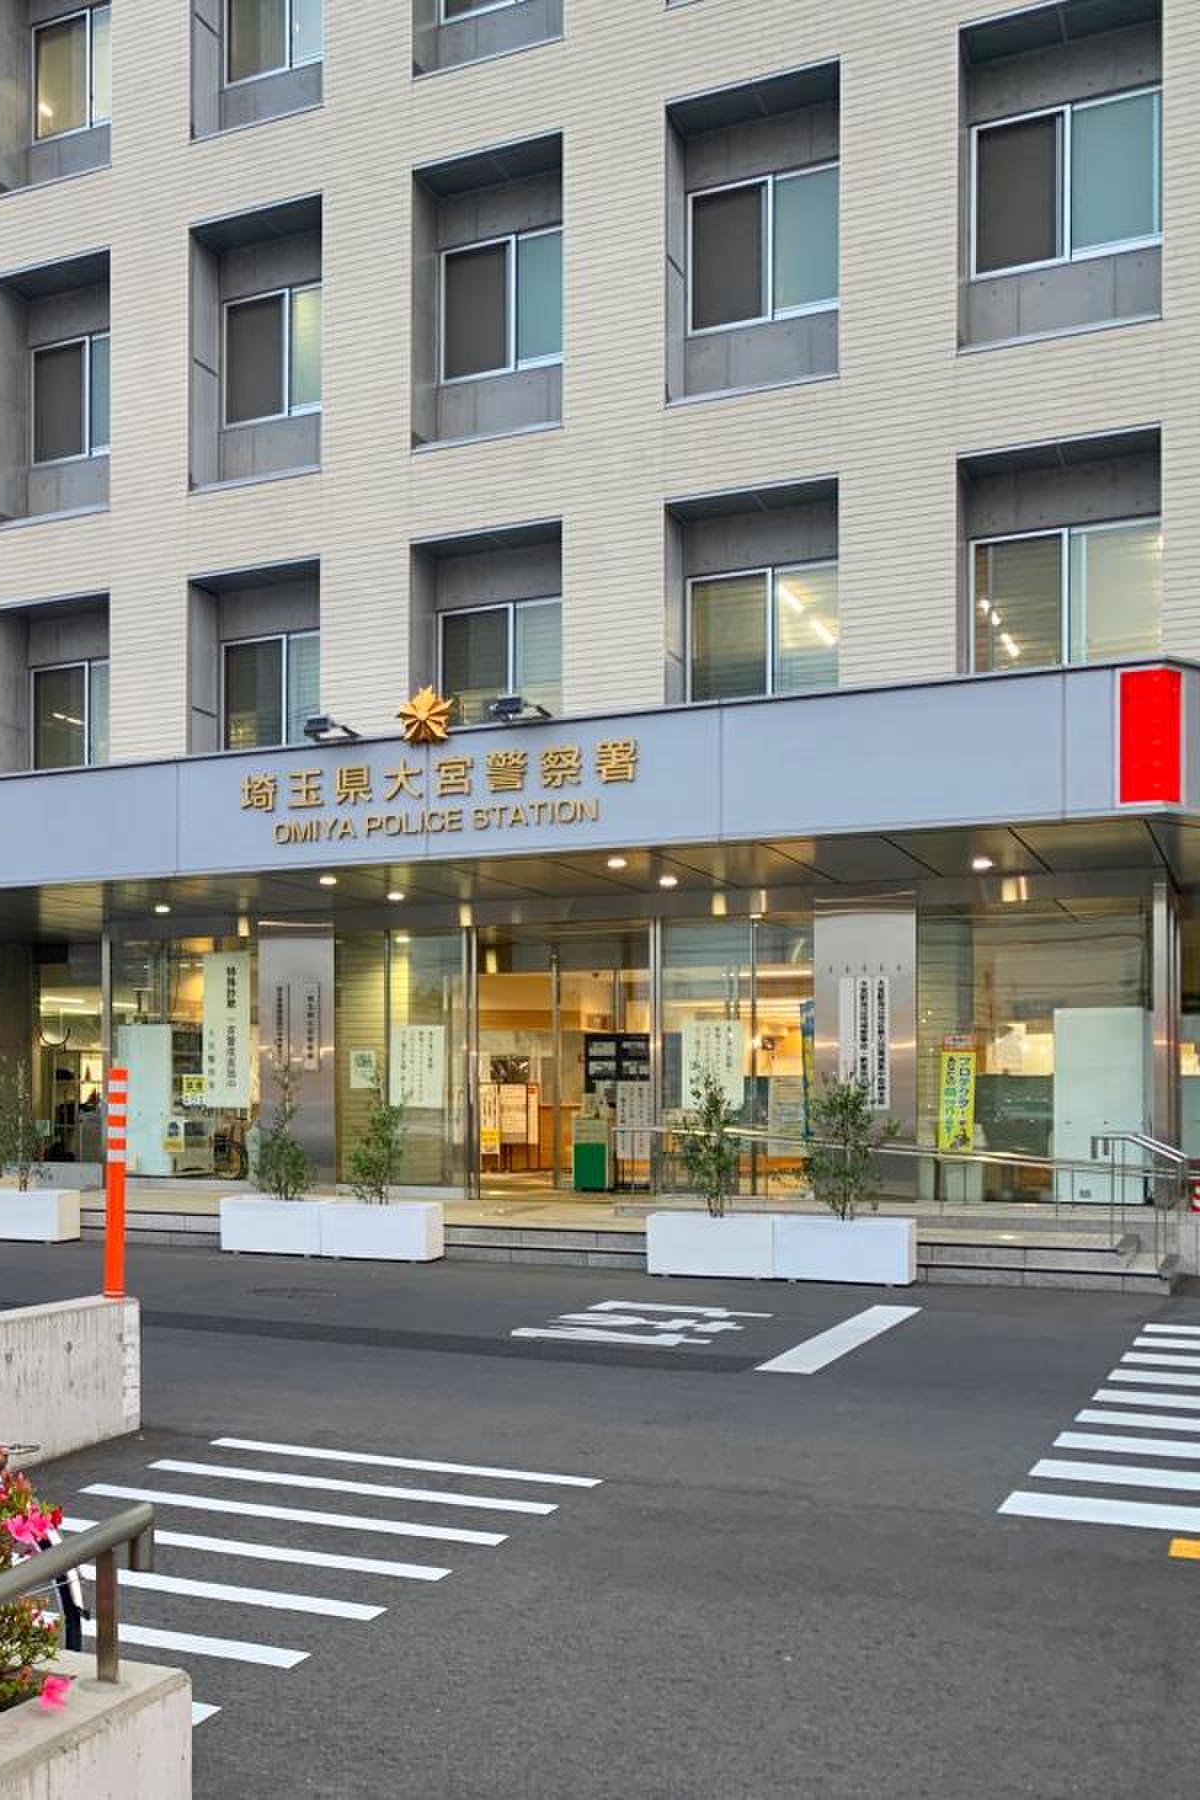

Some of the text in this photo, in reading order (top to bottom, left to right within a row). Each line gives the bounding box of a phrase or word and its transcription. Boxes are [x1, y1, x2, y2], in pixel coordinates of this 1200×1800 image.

[240, 736, 637, 813] 埼玉県大宮警察署
[272, 799, 599, 845] OMIYA POLICE STATION
[510, 1299, 774, 1347] 止まれ
